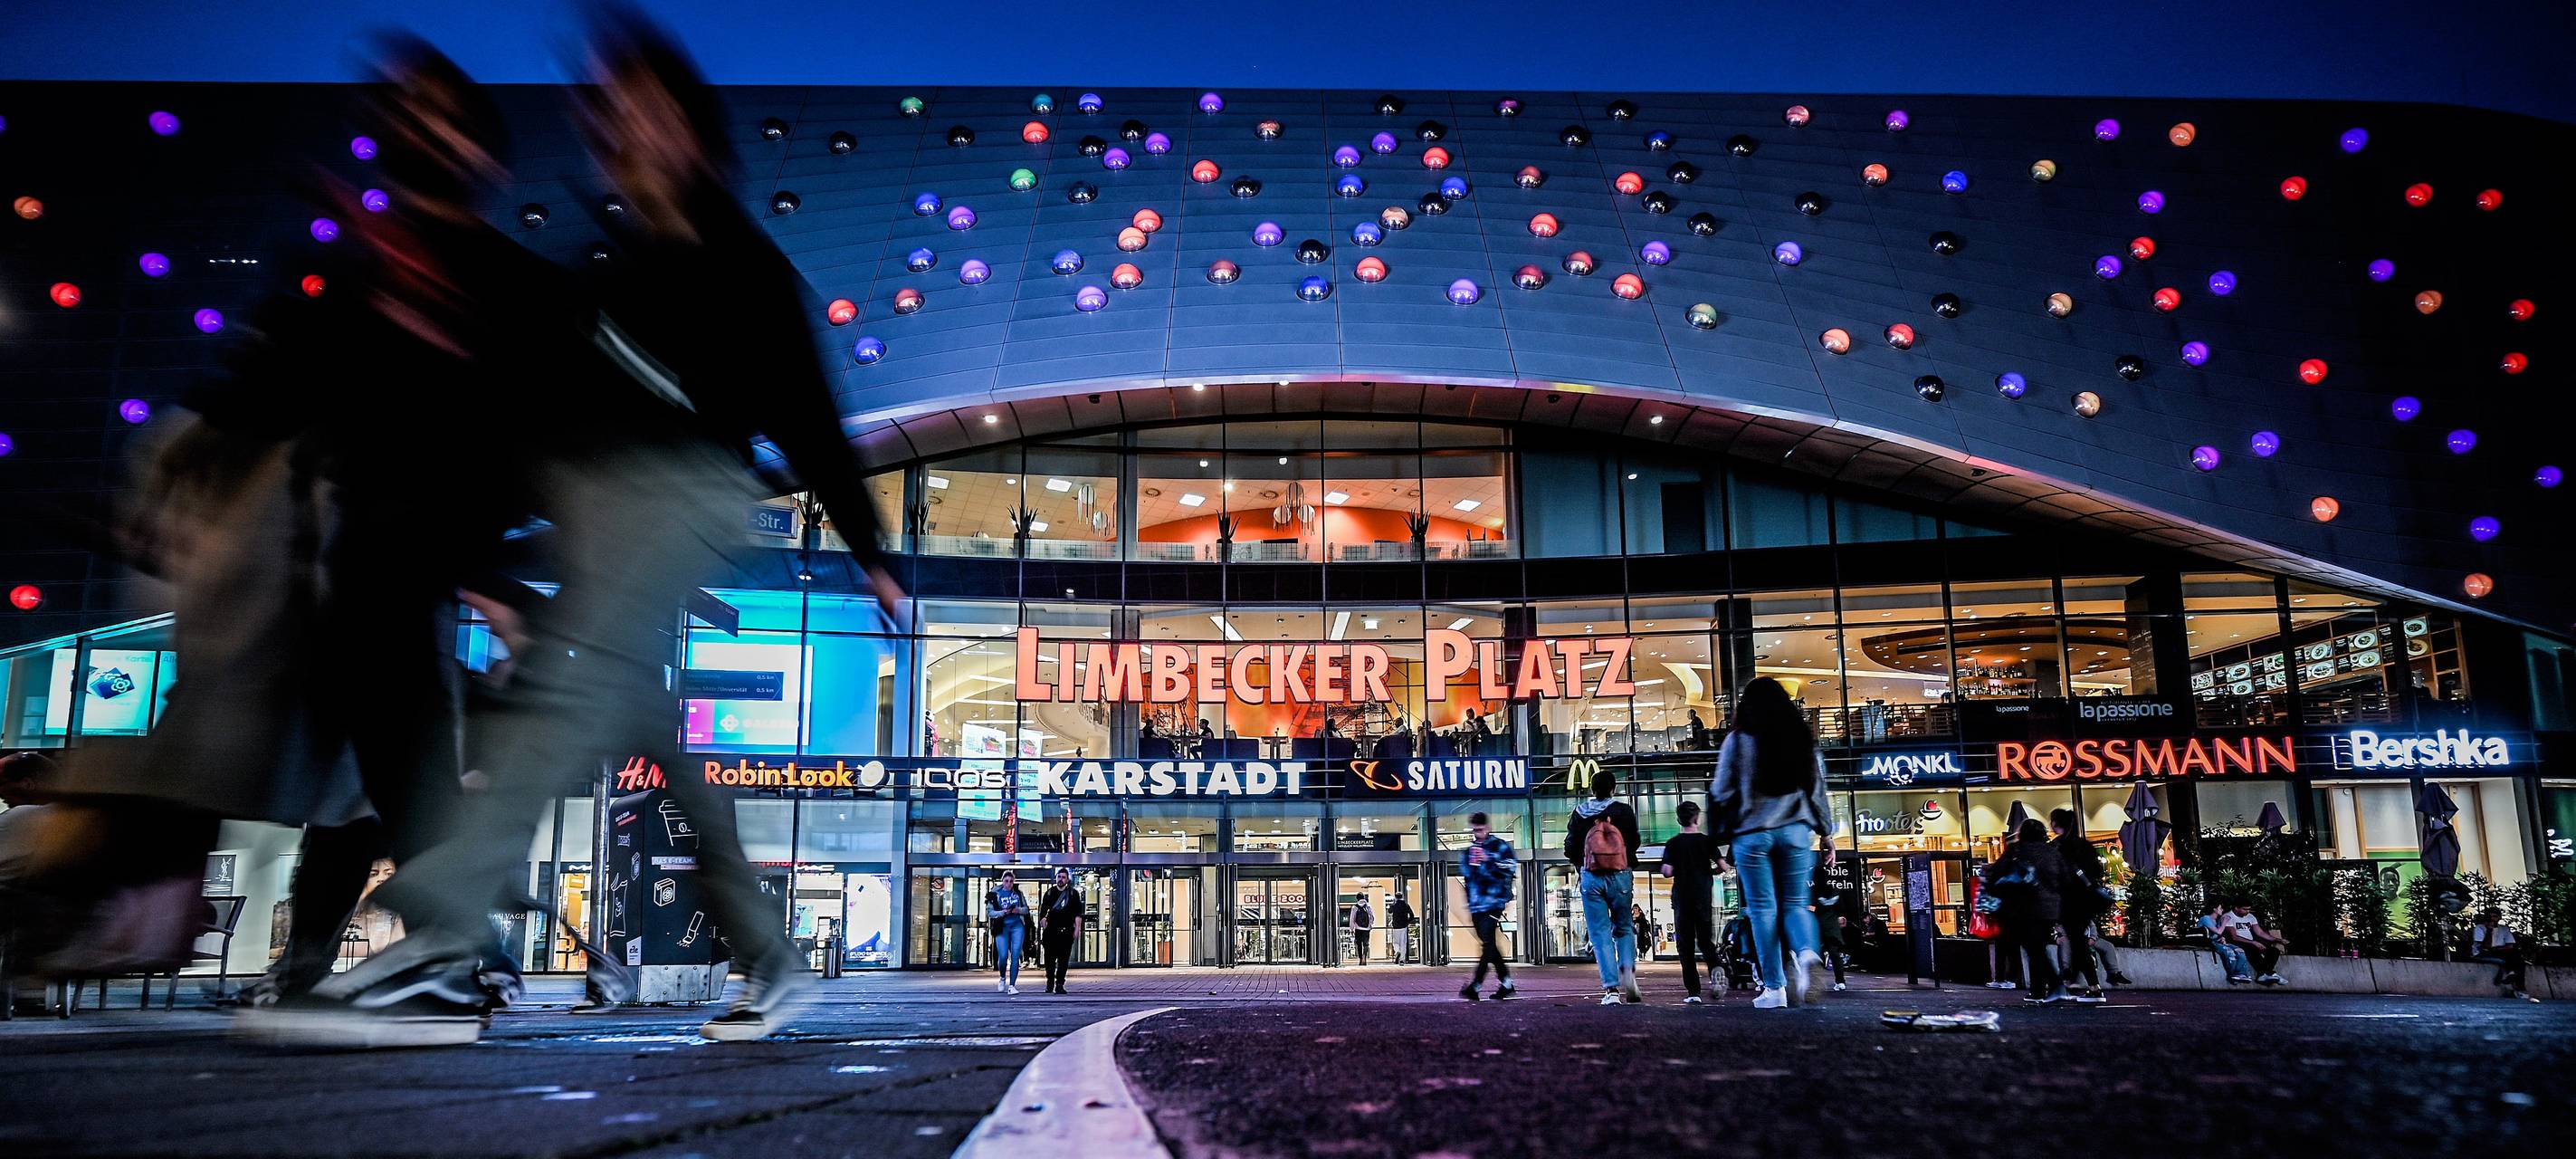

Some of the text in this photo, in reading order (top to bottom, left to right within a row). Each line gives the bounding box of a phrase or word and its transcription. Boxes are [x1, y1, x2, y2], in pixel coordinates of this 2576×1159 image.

[1016, 627, 1636, 704] LIMBECKER PLATZ
[1997, 736, 2297, 780] ROSSMANN
[2350, 729, 2509, 768] Bershka
[704, 759, 854, 787] Robin Look
[917, 767, 1007, 790] IQOS
[1038, 761, 1307, 796] KARSTADT
[1407, 759, 1526, 790] SATURN
